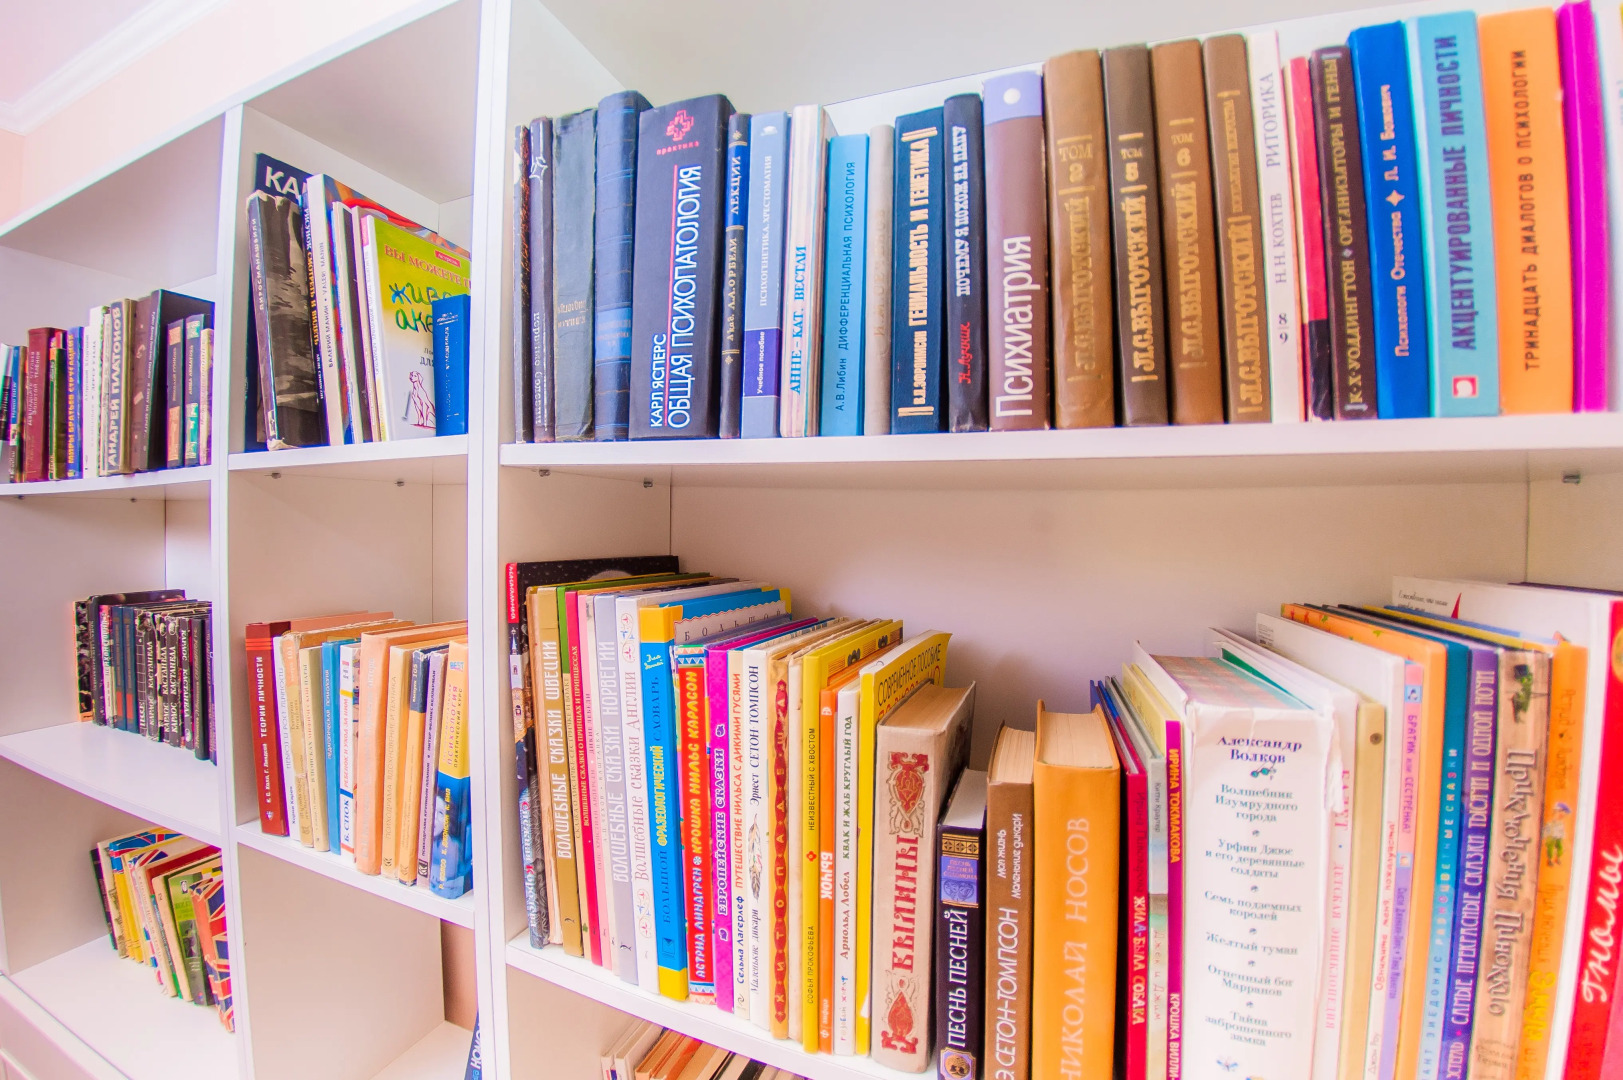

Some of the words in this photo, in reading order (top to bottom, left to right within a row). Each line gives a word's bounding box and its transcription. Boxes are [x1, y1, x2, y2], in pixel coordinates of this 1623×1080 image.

[1262, 72, 1282, 168] РИТОРИКА
[1381, 85, 1396, 140] Божович
[1511, 49, 1531, 149] ПСИХОЛОГИИ
[952, 125, 968, 161] ПАПУ
[1059, 147, 1093, 162] ТОМ
[1121, 147, 1143, 159] ТОМ
[1171, 132, 1193, 143] ТОМ
[1177, 147, 1191, 166] 6
[1384, 146, 1396, 161] И.
[1517, 157, 1532, 165] О
[731, 155, 742, 214] ЛЕКЦИИ
[910, 137, 930, 205] ГЕНЕТИКА
[953, 162, 968, 180] НА
[1125, 162, 1139, 182] 5
[1386, 166, 1399, 181] Л.
[844, 162, 857, 231] ПСИХОЛОГИЯ
[910, 208, 929, 221] И
[954, 181, 969, 226] ПОХОЖ
[1270, 193, 1285, 247] КОХТЕВ
[1517, 173, 1539, 256] ДИАЛОГОВ
[303, 208, 312, 250] РИСУНОК
[955, 227, 969, 237] Я
[1390, 211, 1406, 280] Отечества
[251, 218, 264, 310] ПИРОСМАНАШВИЛИ
[307, 251, 316, 298] СМОТРЕТЬ
[384, 244, 406, 262] ВЫ
[408, 256, 462, 285] МОЖЕТЕ
[671, 165, 702, 347] ПСИХОПАТОЛОГИЯ
[909, 224, 929, 326] ГЕНИАЛЬНОСТЬ
[955, 238, 972, 296] ПОЧЕМУ
[1273, 249, 1286, 266] Н.
[1275, 269, 1287, 283] Н.
[310, 300, 316, 308] И
[838, 236, 854, 350] ДИФФЕРЕНЦИАЛЬНАЯ
[311, 310, 319, 345] ВИДЕТЬ
[322, 305, 330, 332] МАНИН
[995, 236, 1041, 418] Психиатрия
[1394, 286, 1410, 356] Психологи
[1522, 264, 1541, 371] ТРИНАДЦАТЬ
[68, 332, 76, 390] СТРУГАЦКИХ
[110, 307, 121, 394] ПЛАТОНОВ
[324, 334, 334, 368] ВАЛЕРИЙ
[652, 334, 667, 388] ЯСПЕРС
[757, 331, 766, 361] пособие
[668, 354, 695, 428] ОБЩАЯ
[756, 363, 766, 394] Учебное
[835, 358, 847, 411] А.В.Либин
[107, 399, 120, 466] АНДРЕЙ
[650, 393, 665, 427] КАРЛ
[146, 641, 154, 688] КАСТАНЕДА
[169, 646, 177, 695] КАСТАНЕДА
[256, 656, 265, 701] ЛИЧНОСТИ
[542, 641, 560, 699] ШВЕЦИИ
[571, 646, 582, 697] ПРИНЦЕССАХ
[596, 641, 618, 716] НОРВЕГИИ
[1475, 671, 1495, 705] НОЧИ
[170, 702, 178, 733] КАРЛОС
[622, 671, 640, 730] Англии
[650, 676, 663, 741] СЛОВАРЬ
[686, 671, 700, 739] КАРЛСОН
[731, 673, 741, 715] ГУСЯМИ
[747, 665, 759, 725] ТОМПСОН
[258, 703, 268, 738] ТЕОРИИ
[447, 686, 458, 765] ПСИХОЛОГИЯ
[546, 709, 565, 764] СКАЗКИ
[575, 705, 585, 742] ПРИНЦАХ
[732, 717, 742, 763] ДИКИМИ
[843, 716, 853, 735] ГОД
[1216, 736, 1302, 752] Александр
[1472, 711, 1494, 756] ОДНОЙ
[578, 750, 587, 781] СКАЗКИ
[601, 728, 621, 783] СКАЗКИ
[626, 736, 644, 790] сказки
[687, 744, 700, 795] НИЛЬС
[748, 729, 759, 768] СЕТОН
[807, 728, 815, 764] ХВОСТОМ
[842, 737, 853, 790] КРУГЛЫЙ
[1168, 748, 1180, 789] ИРИНА
[1230, 748, 1286, 764] Волков
[1471, 761, 1490, 771] И
[650, 745, 668, 846] ФРАЗЕОЛОГИЧЕСКИЙ
[713, 749, 726, 808] СКАЗКИ
[732, 774, 742, 816] НИЛЬСА
[749, 773, 761, 807] Эрнест
[1154, 782, 1163, 802] Китти
[551, 774, 573, 859] ВОЛШЕБНЫЕ
[580, 782, 590, 827] ВОЛШЕБНЫЕ
[806, 774, 815, 831] НЕИЗВЕСТНЫЙ
[843, 793, 852, 818] ЖАБ
[843, 820, 851, 828] И
[1153, 804, 1163, 833] Краутер
[1236, 811, 1277, 823] города
[1467, 777, 1490, 828] ТЫСЯЧИ
[1496, 749, 1539, 900] Приключения
[344, 833, 350, 842] Б.
[605, 793, 629, 883] ВОЛШЕБНЫЕ
[630, 796, 650, 882] Волшебные
[689, 799, 703, 854] КРОШКА
[842, 830, 852, 859] КВАК
[996, 830, 1008, 859] жизнь
[1011, 813, 1024, 848] дикари
[1169, 792, 1180, 863] ТОКМАКОВА
[714, 812, 728, 915] ЕВРОПЕЙСКИЕ
[732, 818, 743, 889] ПУТЕШЕСТВИЕ
[820, 852, 832, 899] БЫЧОК
[996, 860, 1006, 879] Моя
[1010, 850, 1022, 899] Маленькие
[1230, 865, 1279, 879] солдаты
[1463, 835, 1485, 886] СКАЗКИ
[658, 850, 671, 924] БОЛЬШОЙ
[691, 867, 704, 931] ЛИНДГРЕН
[840, 871, 850, 907] Лобел
[891, 835, 918, 973] БЫЛИНЫ
[734, 895, 745, 946] Лагерлеф
[750, 908, 761, 943] дикари
[839, 909, 850, 960] Арнольд
[1132, 896, 1145, 970] ЖИЛА-БЫЛА
[1456, 892, 1481, 973] ПРЕКРАСНЫЕ
[693, 933, 706, 978] АСТРИД
[735, 948, 745, 984] Сельма
[806, 925, 814, 976] ПРОКОФЬЕВА
[944, 909, 968, 982] ПЕСНЕЙ
[1486, 910, 1526, 1017] Пиноккио
[750, 945, 760, 995] Маленькие
[806, 977, 814, 1004] СОФЬЯ
[947, 984, 966, 1048] ПЕСНЬ
[1132, 975, 1146, 1024] СОБАКА
[1169, 993, 1181, 1039] КРОШКА
[1450, 978, 1473, 1025] САМЫЕ
[1169, 1041, 1181, 1080] ВИЛЛИ-
